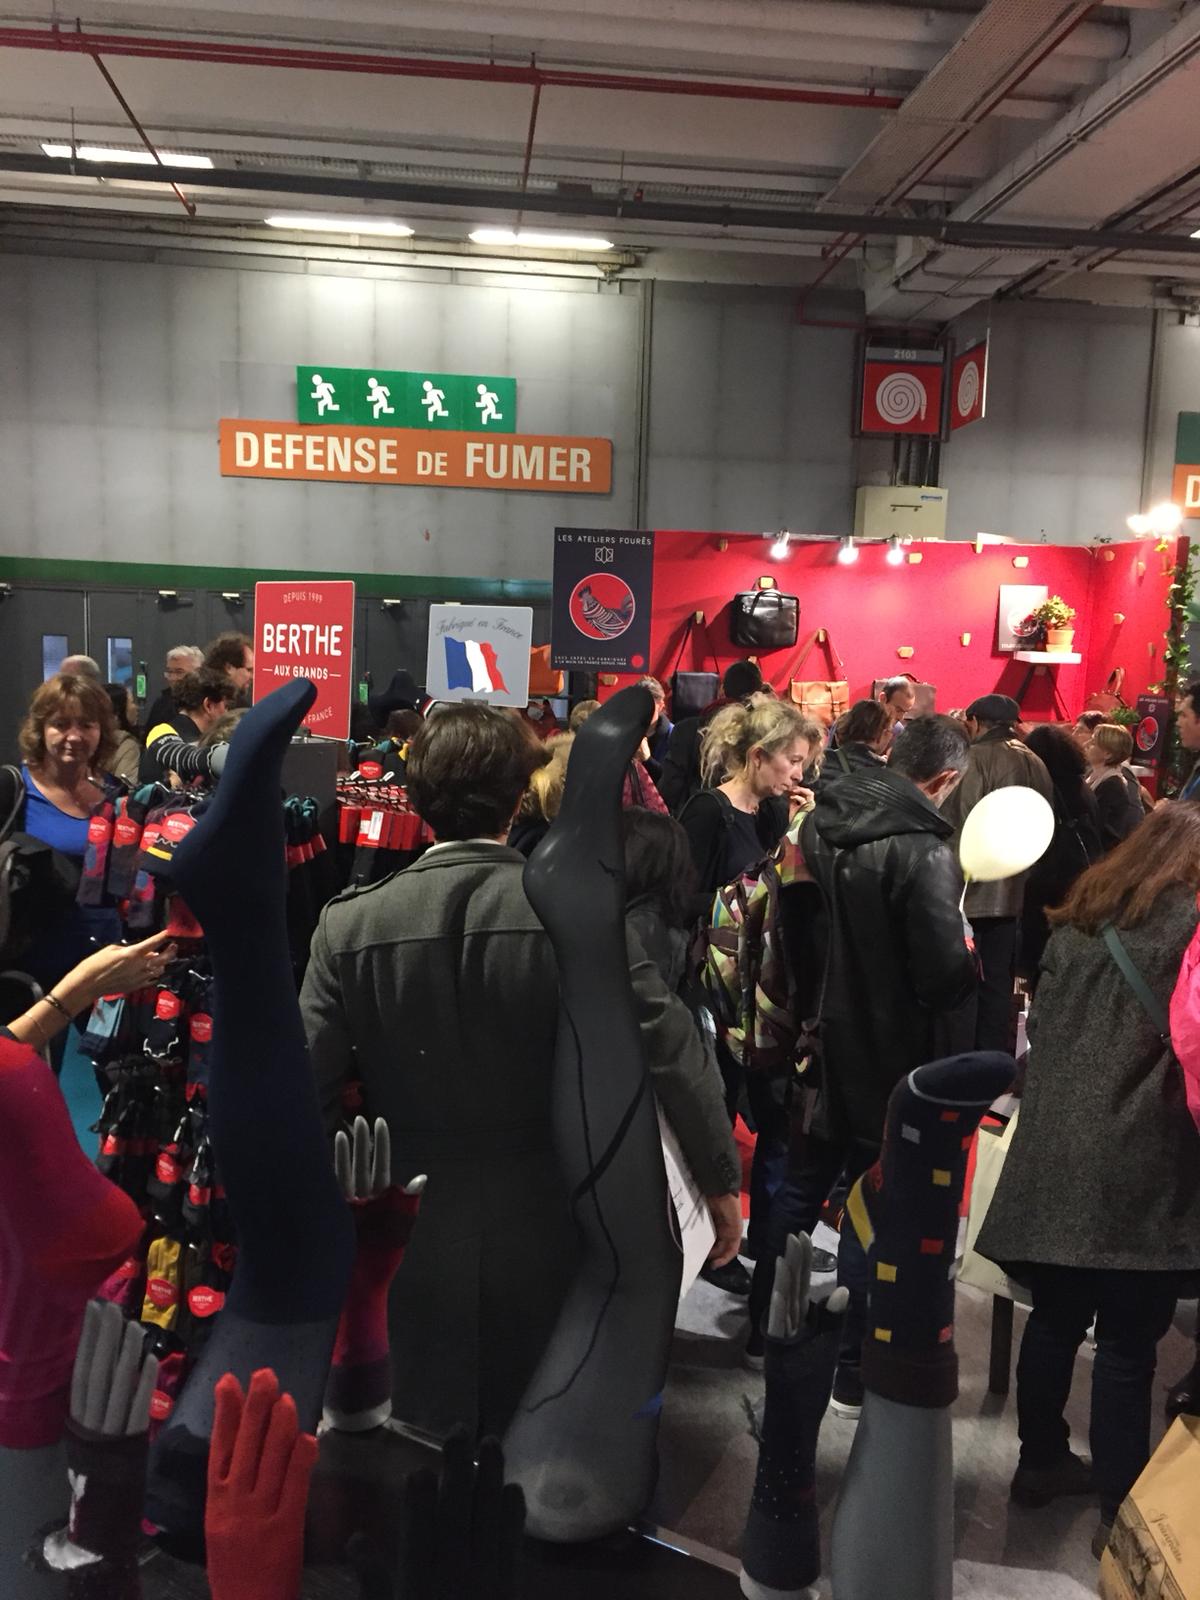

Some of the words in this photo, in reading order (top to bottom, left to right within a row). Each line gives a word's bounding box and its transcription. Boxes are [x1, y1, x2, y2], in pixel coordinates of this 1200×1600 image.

[893, 350, 917, 360] 2103
[235, 432, 398, 474] DEFENSE
[416, 451, 448, 476] DE
[466, 442, 591, 482] FUMER
[557, 534, 573, 542] LES
[577, 535, 616, 544] ATELIERS
[283, 591, 306, 604] DEPUIS
[493, 617, 523, 639] France
[263, 623, 343, 656] BERTHE
[273, 664, 291, 677] AUX
[293, 666, 328, 680] GRANDS
[308, 706, 333, 724] FRANCE
